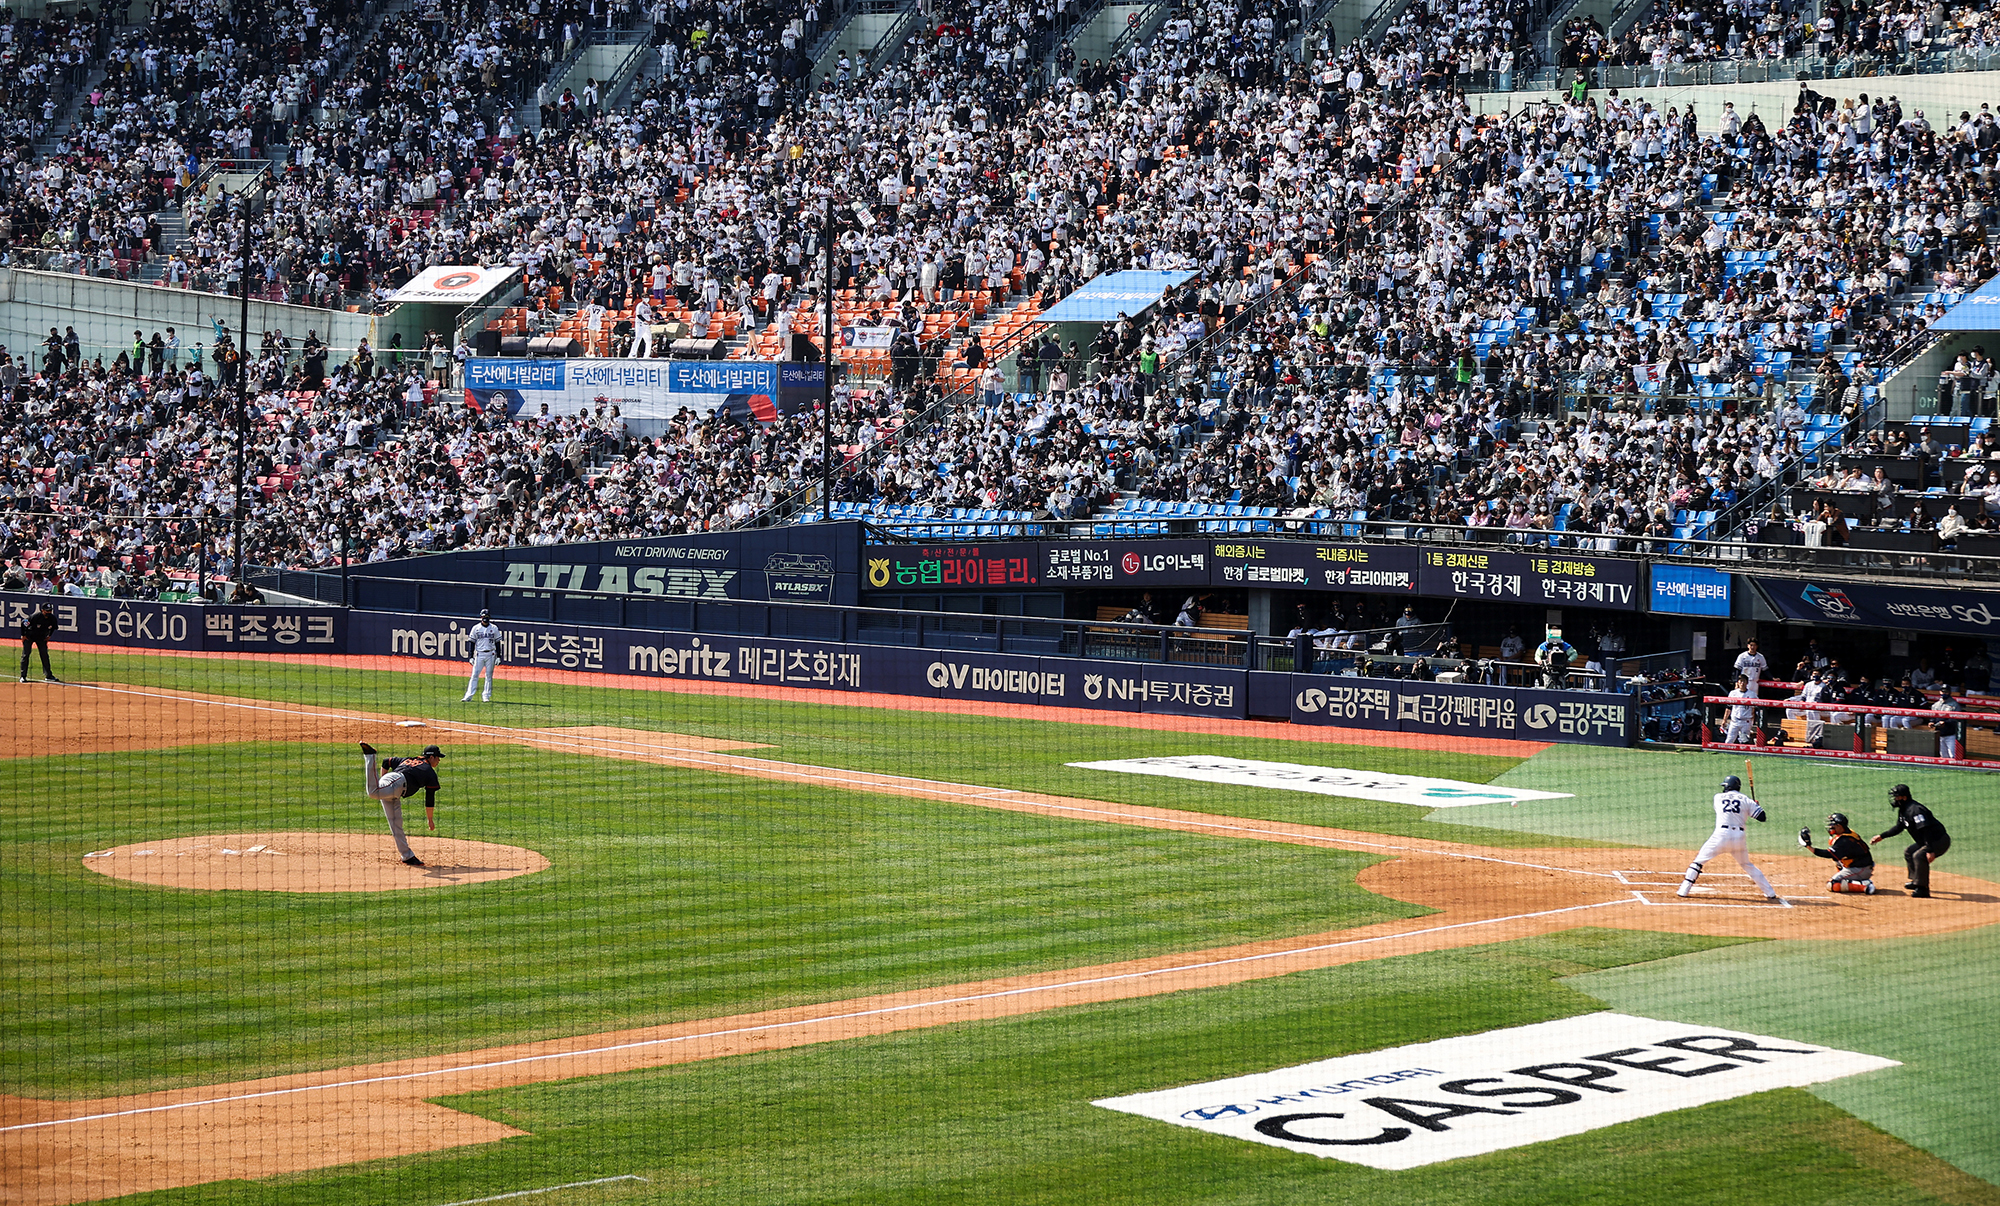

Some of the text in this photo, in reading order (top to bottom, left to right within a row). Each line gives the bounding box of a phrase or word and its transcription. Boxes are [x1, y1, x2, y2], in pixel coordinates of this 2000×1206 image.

[319, 121, 336, 131] 204
[471, 365, 556, 386] 두산에너빌리티
[571, 367, 661, 387] 두산에너빌리티
[677, 369, 769, 389] 두산에너빌리티
[615, 545, 729, 561] NEXT DRIVING ENERGY
[1048, 549, 1110, 563] 글로벌 No.1
[1214, 544, 1266, 559] 해외증시는
[1315, 547, 1368, 563] 국내증시는
[1426, 552, 1489, 570] 1등 경제신문
[1223, 566, 1243, 581] 한경
[1324, 569, 1345, 585] 한경
[1530, 559, 1596, 578] 1등 경제방송
[498, 563, 738, 604] ATLASBX
[774, 582, 824, 593] ATLASBX
[1451, 570, 1521, 597] 한국경제
[1655, 581, 1727, 600] 두산에너빌리티
[1886, 602, 1953, 619] 신한은행
[205, 613, 335, 644] 백조씽크
[628, 637, 731, 677] meritz
[738, 646, 861, 687] 메리츠화재
[926, 661, 1065, 697] QV 마이데이터
[1327, 686, 1390, 720] 금강주택
[1421, 693, 1518, 730] 금강펜테리움
[1558, 700, 1625, 736] 금강주택
[1721, 799, 1740, 813] 23
[1254, 1034, 1817, 1147] CASPER
[1256, 1067, 1444, 1105] HYUNDAI
